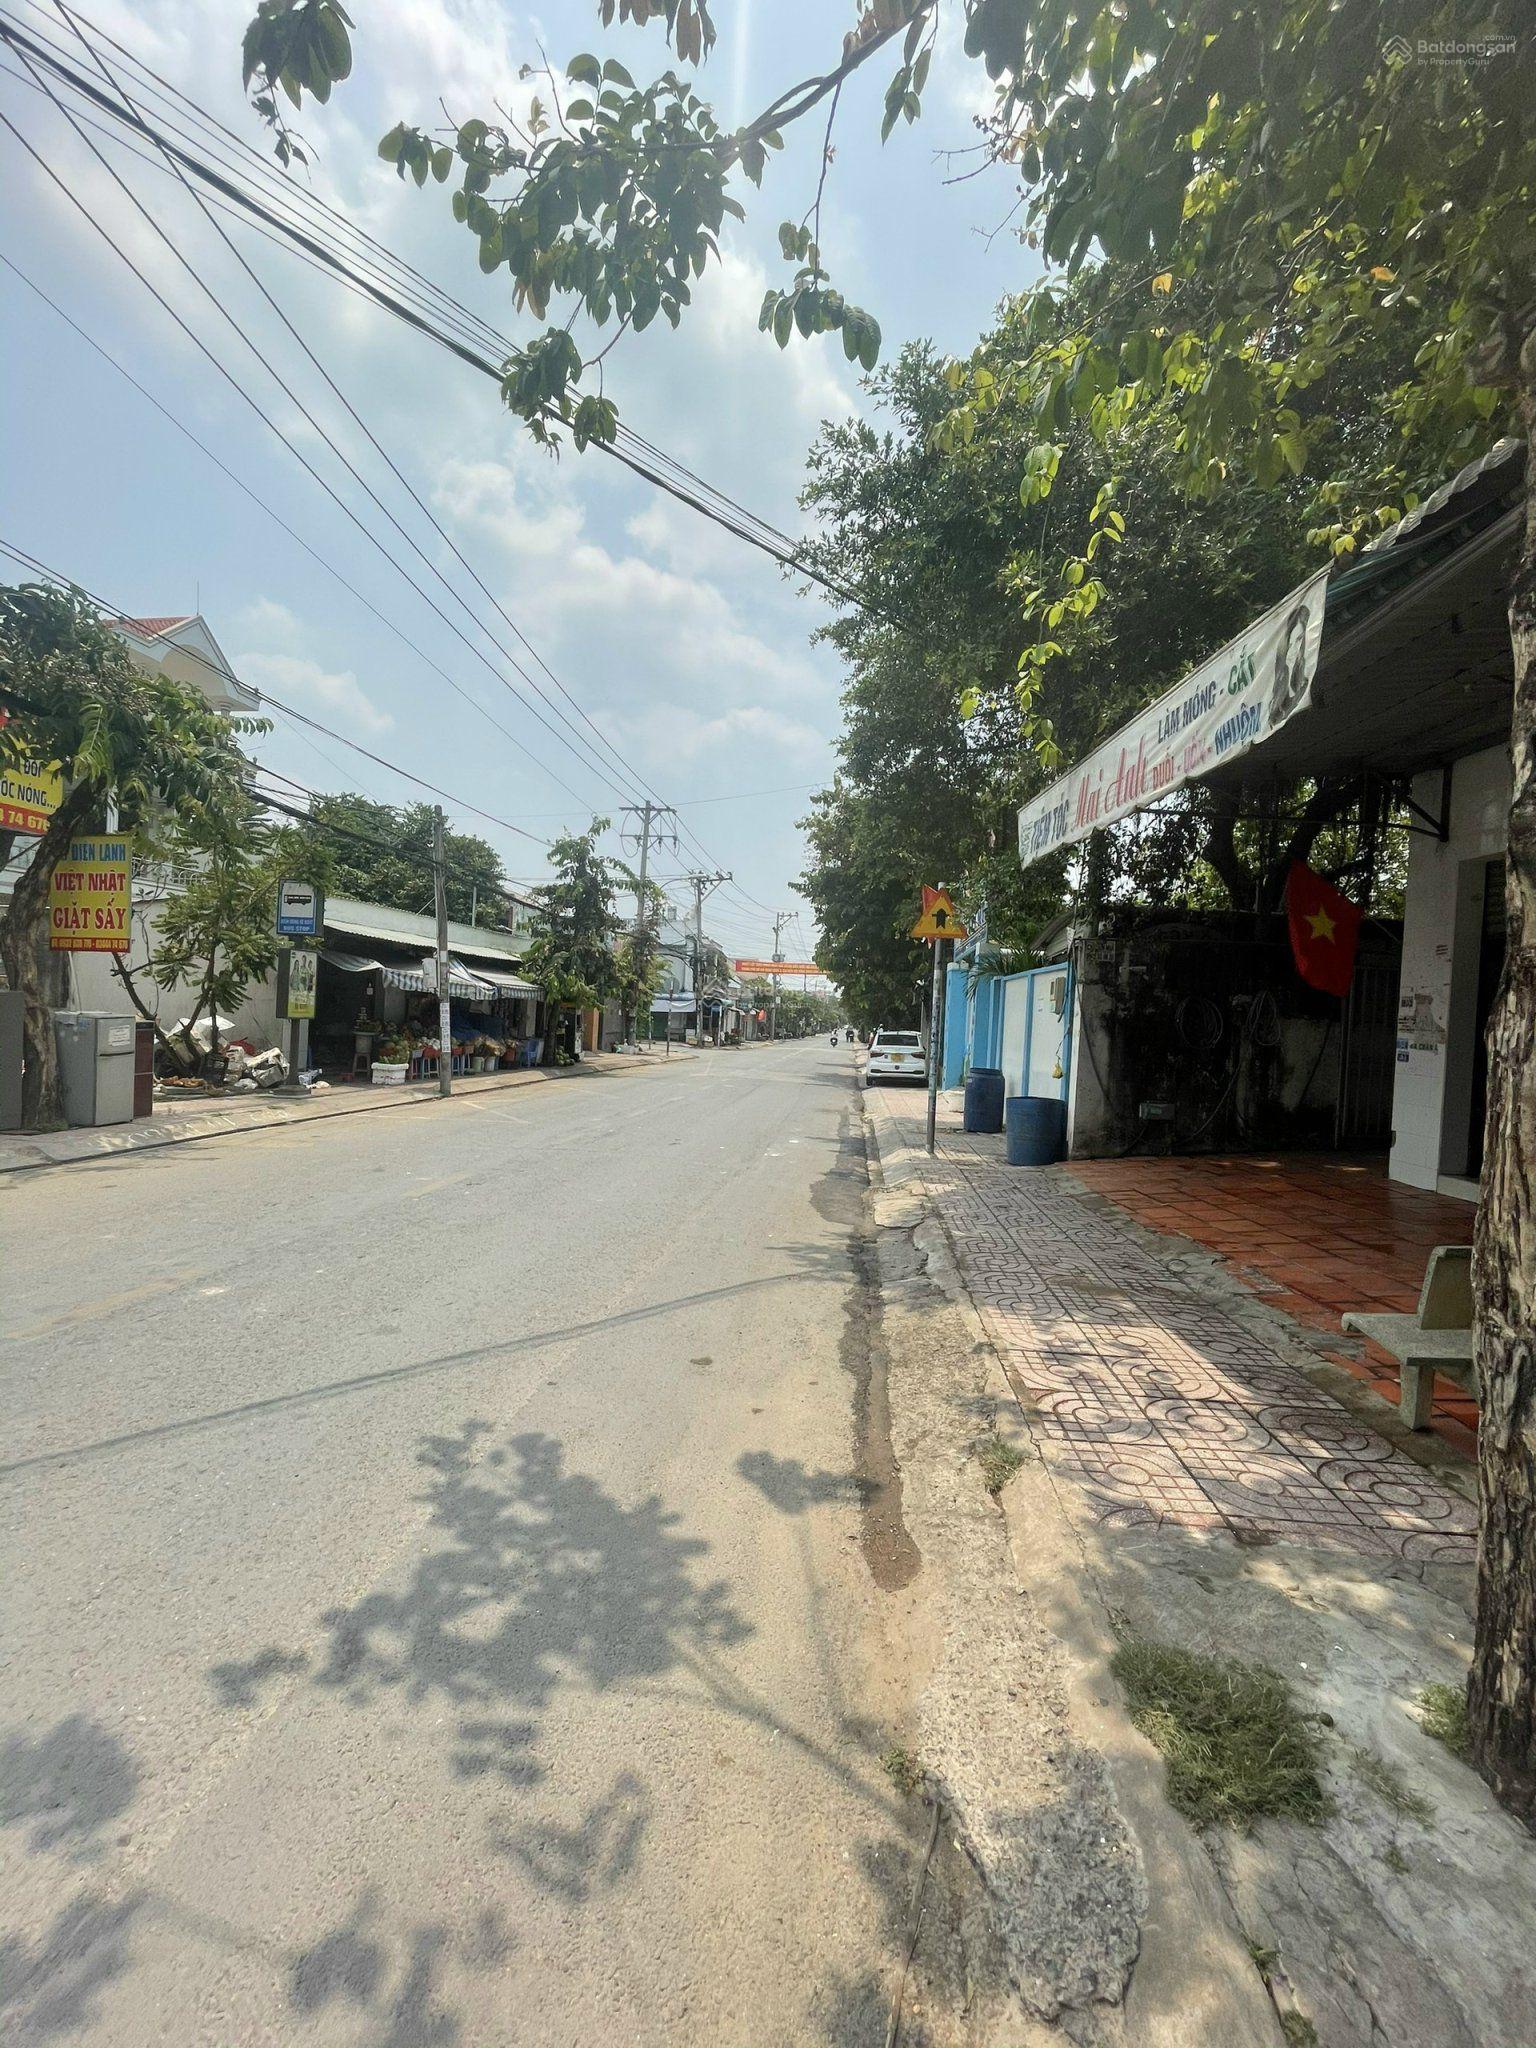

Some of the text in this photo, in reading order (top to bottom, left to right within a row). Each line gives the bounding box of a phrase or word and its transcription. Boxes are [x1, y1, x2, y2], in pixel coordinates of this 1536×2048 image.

[1158, 706, 1180, 744] LÀM
[1183, 680, 1217, 727] MÓNG
[1227, 644, 1255, 695] CẮT
[1072, 768, 1104, 829] Mai
[1104, 735, 1147, 814] Anh
[8, 810, 24, 825] 74
[71, 843, 95, 864] ĐIỆN
[54, 869, 126, 895] VIỆT NHẬT
[53, 897, 127, 935] GIẶT SẤY
